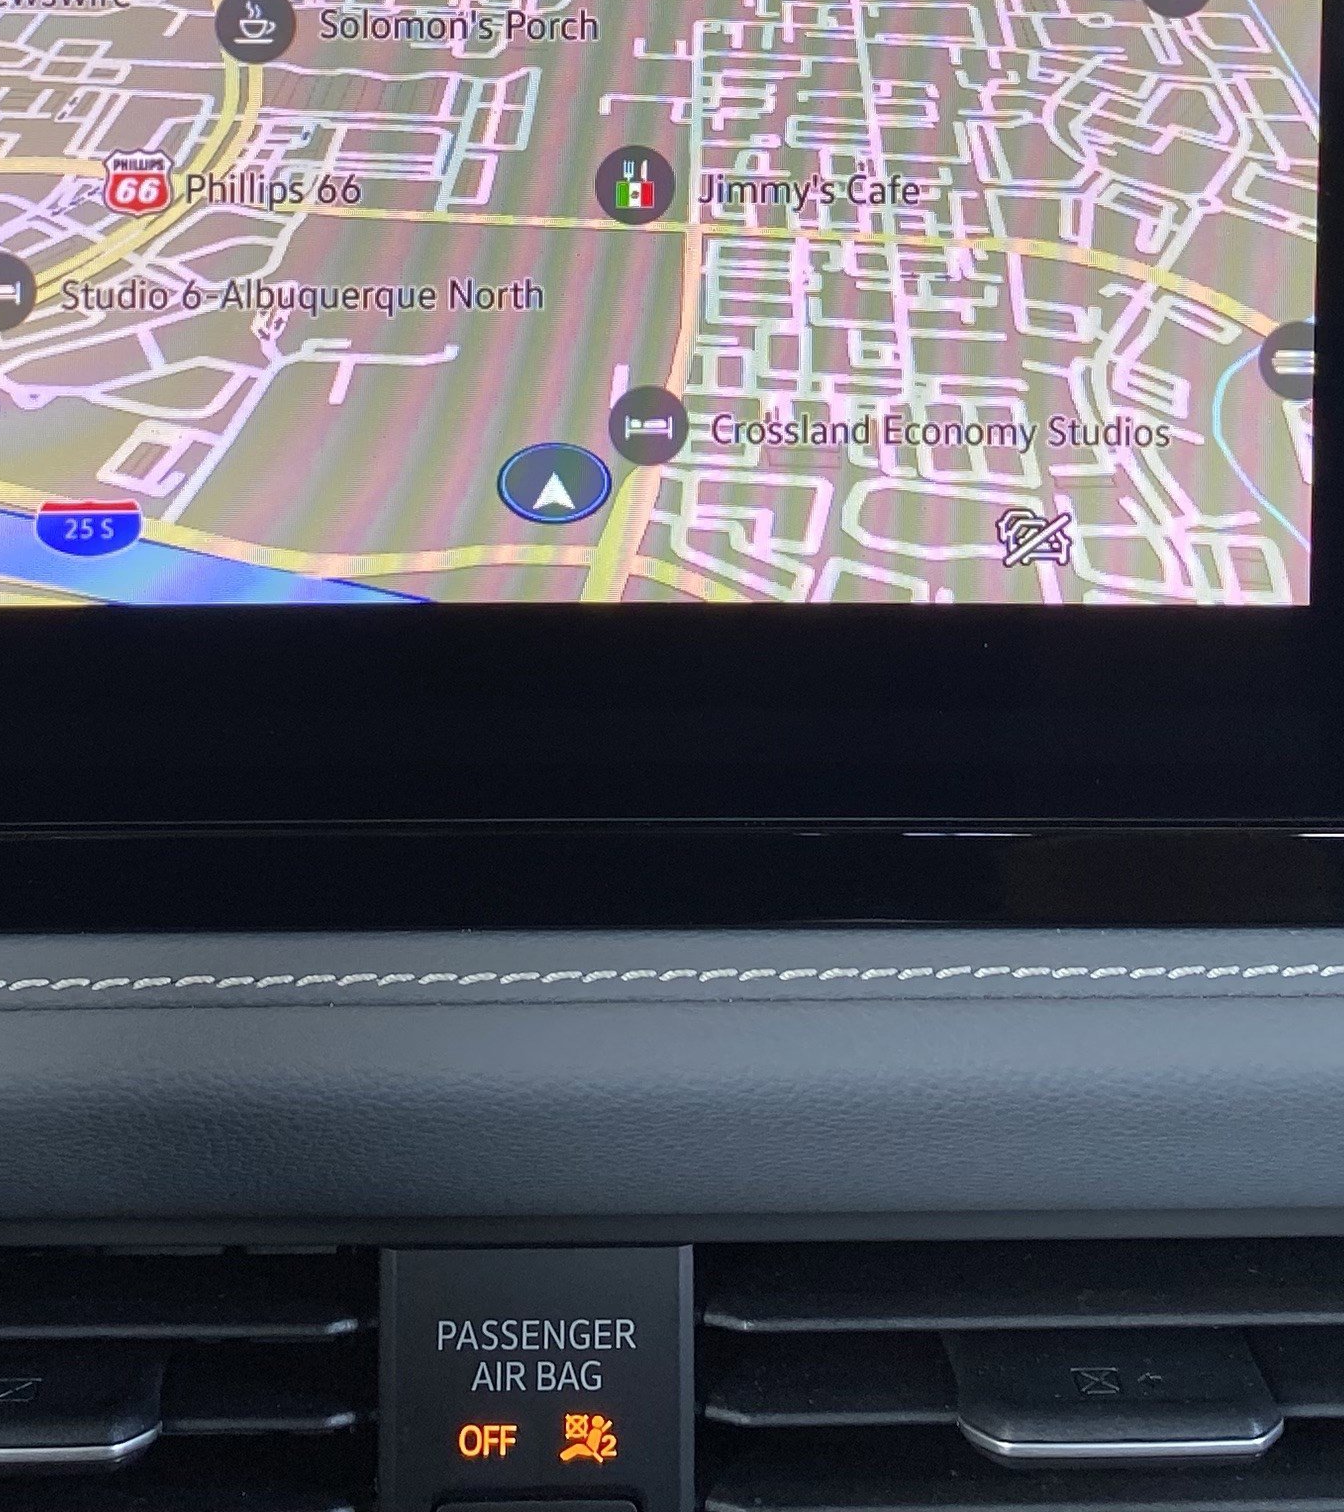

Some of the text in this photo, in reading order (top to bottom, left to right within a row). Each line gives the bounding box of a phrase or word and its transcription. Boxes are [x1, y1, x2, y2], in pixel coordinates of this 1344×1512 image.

[319, 8, 599, 42] Solomon's Porch
[112, 157, 165, 172] PHILLIPS
[114, 177, 161, 205] 66
[186, 171, 362, 212] Phillips 66
[699, 173, 921, 211] Jimmy's Cafe
[60, 278, 544, 319] Studio 6-Albuquerque North
[711, 413, 1171, 456] Crossland Economy Studios
[64, 518, 115, 540] 25 S
[436, 1318, 637, 1351] PASSENGER
[470, 1360, 603, 1392] AIR BAG
[458, 1423, 518, 1458] OFF
